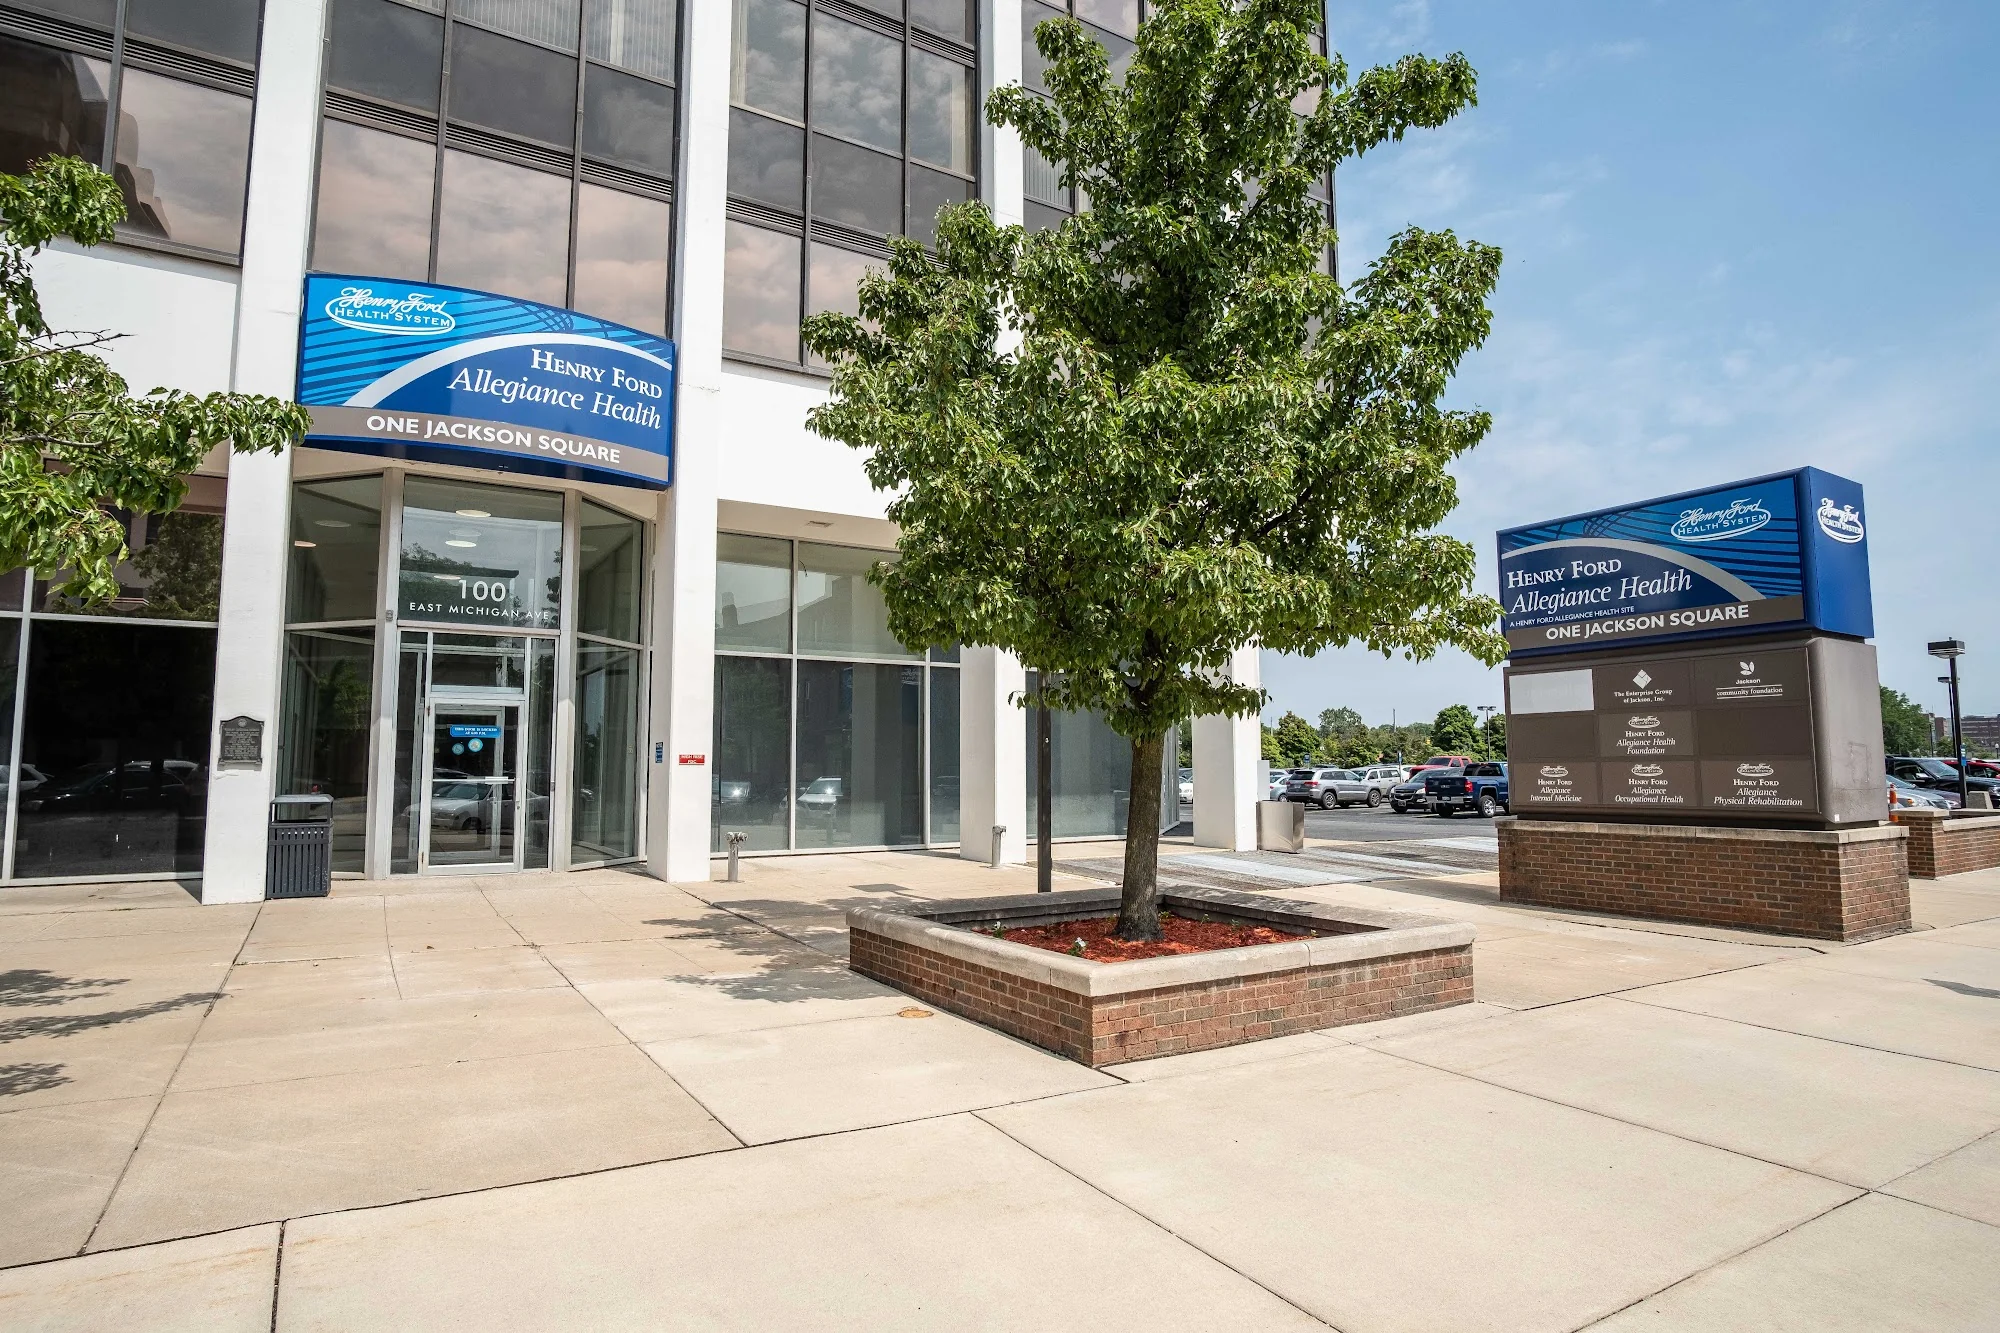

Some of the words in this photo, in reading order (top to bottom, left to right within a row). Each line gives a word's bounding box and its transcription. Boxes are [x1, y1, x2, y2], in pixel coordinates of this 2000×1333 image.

[339, 287, 403, 314] Henry
[401, 293, 447, 313] Ford
[335, 307, 389, 320] HEALTH
[395, 312, 450, 327] SYSTEM
[531, 348, 606, 383] HENRY
[612, 367, 663, 399] FORD
[447, 367, 585, 410] Allegiance
[590, 391, 662, 430] Health
[366, 415, 419, 434] ONE
[424, 420, 532, 448] JACKSON
[538, 435, 621, 464] SQUARE
[1680, 508, 1728, 528] Henry
[1727, 497, 1762, 519] Ford
[1678, 522, 1719, 535] HEALTH
[1723, 513, 1767, 528] SYSTEM
[1507, 567, 1566, 589] HENRY
[1571, 558, 1622, 579] FORD
[459, 579, 506, 602] 100
[1509, 585, 1612, 615] Allegiance
[1618, 568, 1693, 601] Health
[409, 602, 443, 613] EAST
[449, 605, 520, 619] MICHIGAN
[526, 610, 550, 620] AVE
[1515, 619, 1536, 627] HENRY
[1536, 617, 1554, 625] FORD
[1554, 612, 1593, 622] ALLEGIANCE
[1594, 608, 1620, 617] HEALTH
[1620, 605, 1635, 614] SITE
[1545, 624, 1581, 640] ONE
[1583, 614, 1665, 639] JACKSON
[1669, 604, 1750, 628] SQUARE
[1654, 688, 1673, 696] Group
[1716, 689, 1749, 697] community
[1750, 687, 1783, 695] foundation
[1625, 730, 1647, 738] HENRY
[1616, 738, 1651, 748] Allegiance
[1652, 737, 1676, 746] Health
[1626, 746, 1666, 755] Foundation
[1650, 778, 1669, 786] FORD
[1733, 778, 1758, 786] HENRY
[1758, 778, 1780, 787] FORD
[1540, 786, 1571, 795] Allegiance
[1631, 786, 1667, 796] Allegiance
[1736, 787, 1778, 798] Allegiance
[1554, 794, 1582, 802] Medicine
[1614, 794, 1659, 804] Occupational
[1660, 795, 1684, 804] Health
[1713, 796, 1746, 806] Physical
[1747, 796, 1803, 806] Rehabilitation
